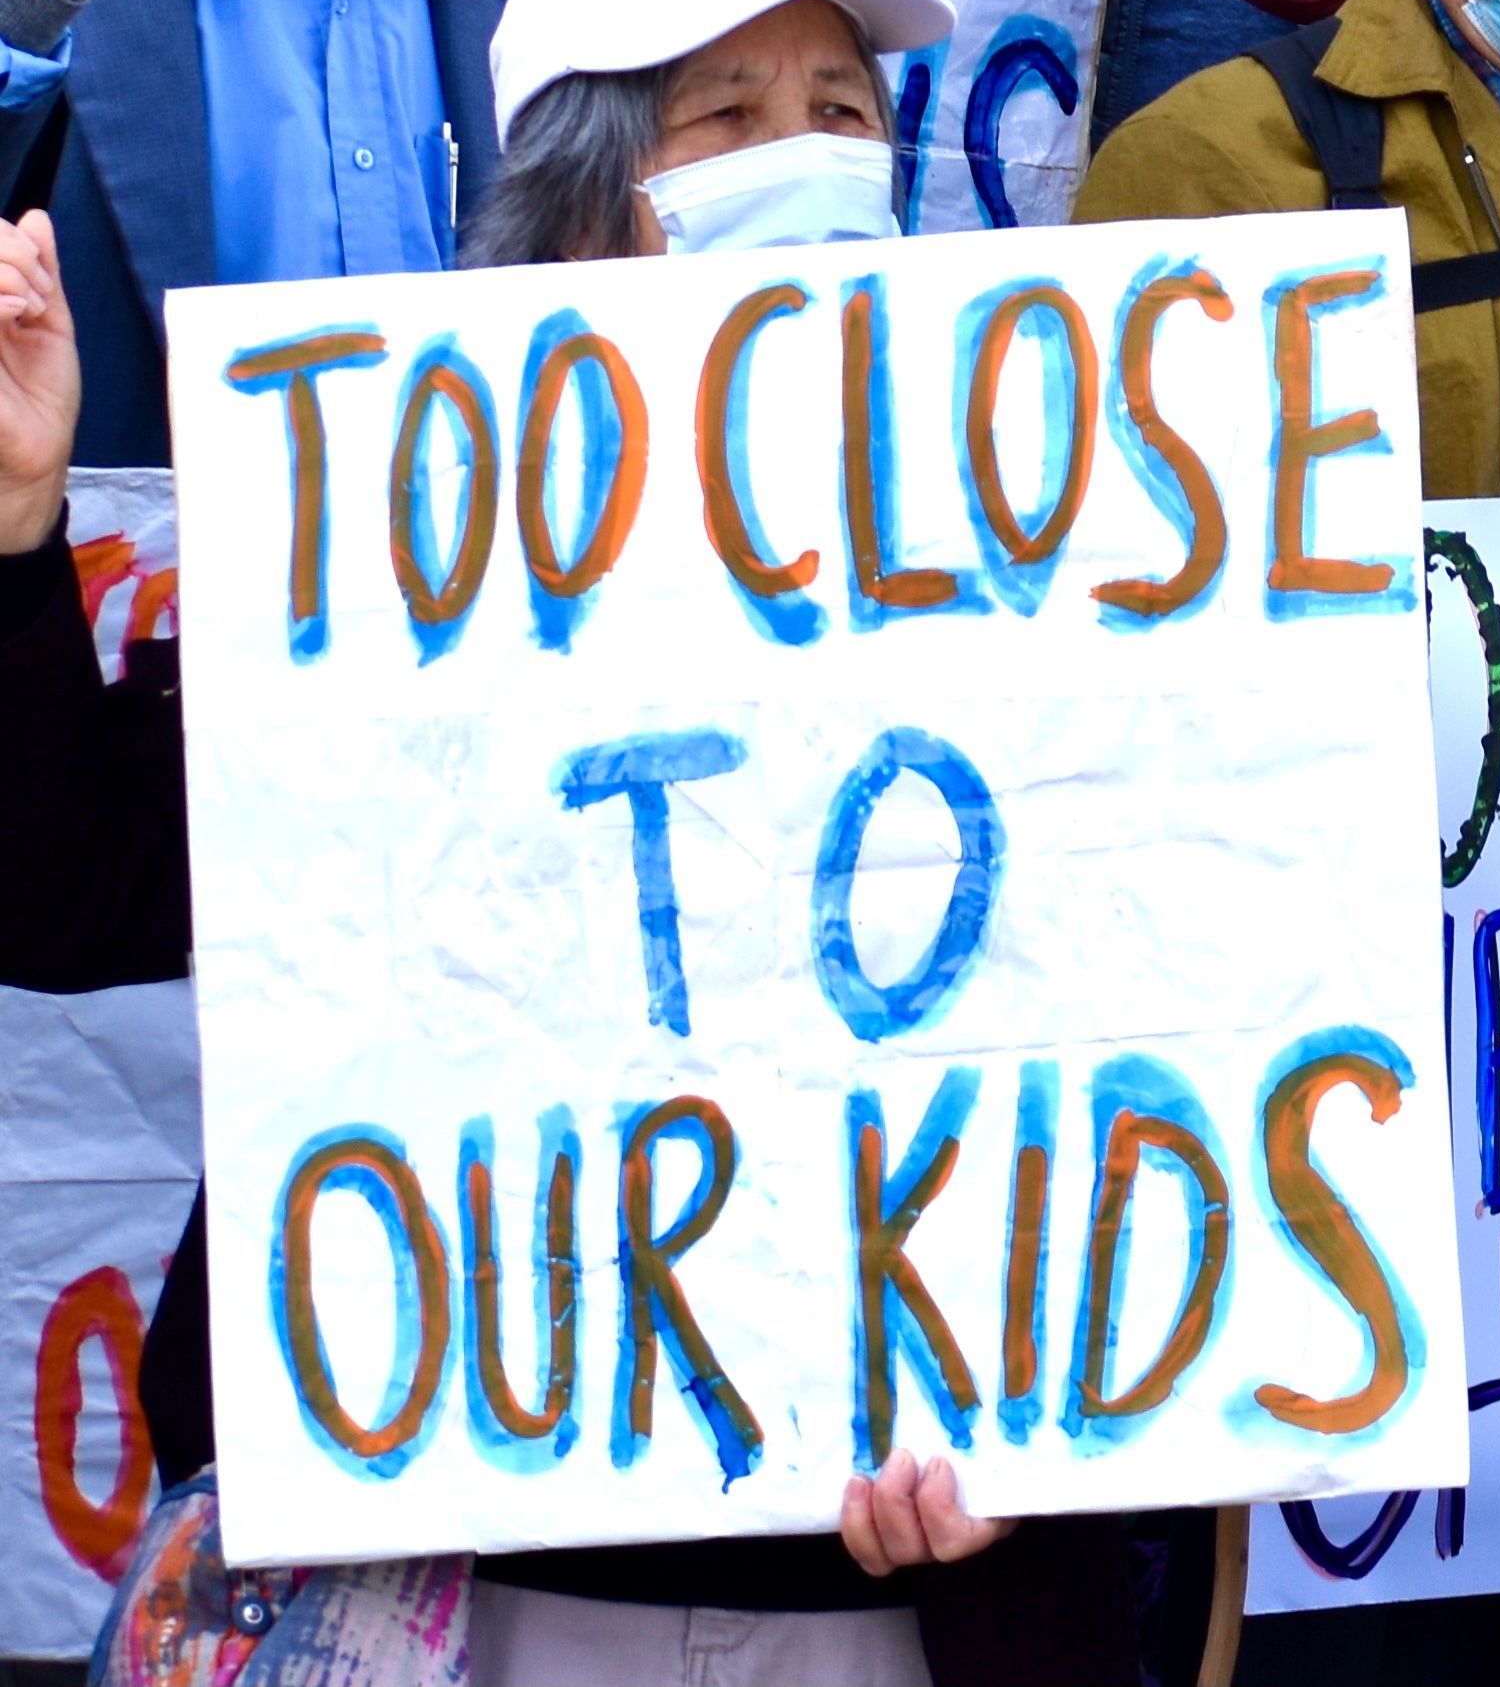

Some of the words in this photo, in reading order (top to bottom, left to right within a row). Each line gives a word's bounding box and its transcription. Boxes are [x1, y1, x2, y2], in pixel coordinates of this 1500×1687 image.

[222, 322, 652, 667] TOO
[694, 252, 1418, 647] CLOSE
[548, 724, 1008, 1044] TO
[268, 1082, 768, 1492] OUR
[848, 1022, 1428, 1474] KIDS
